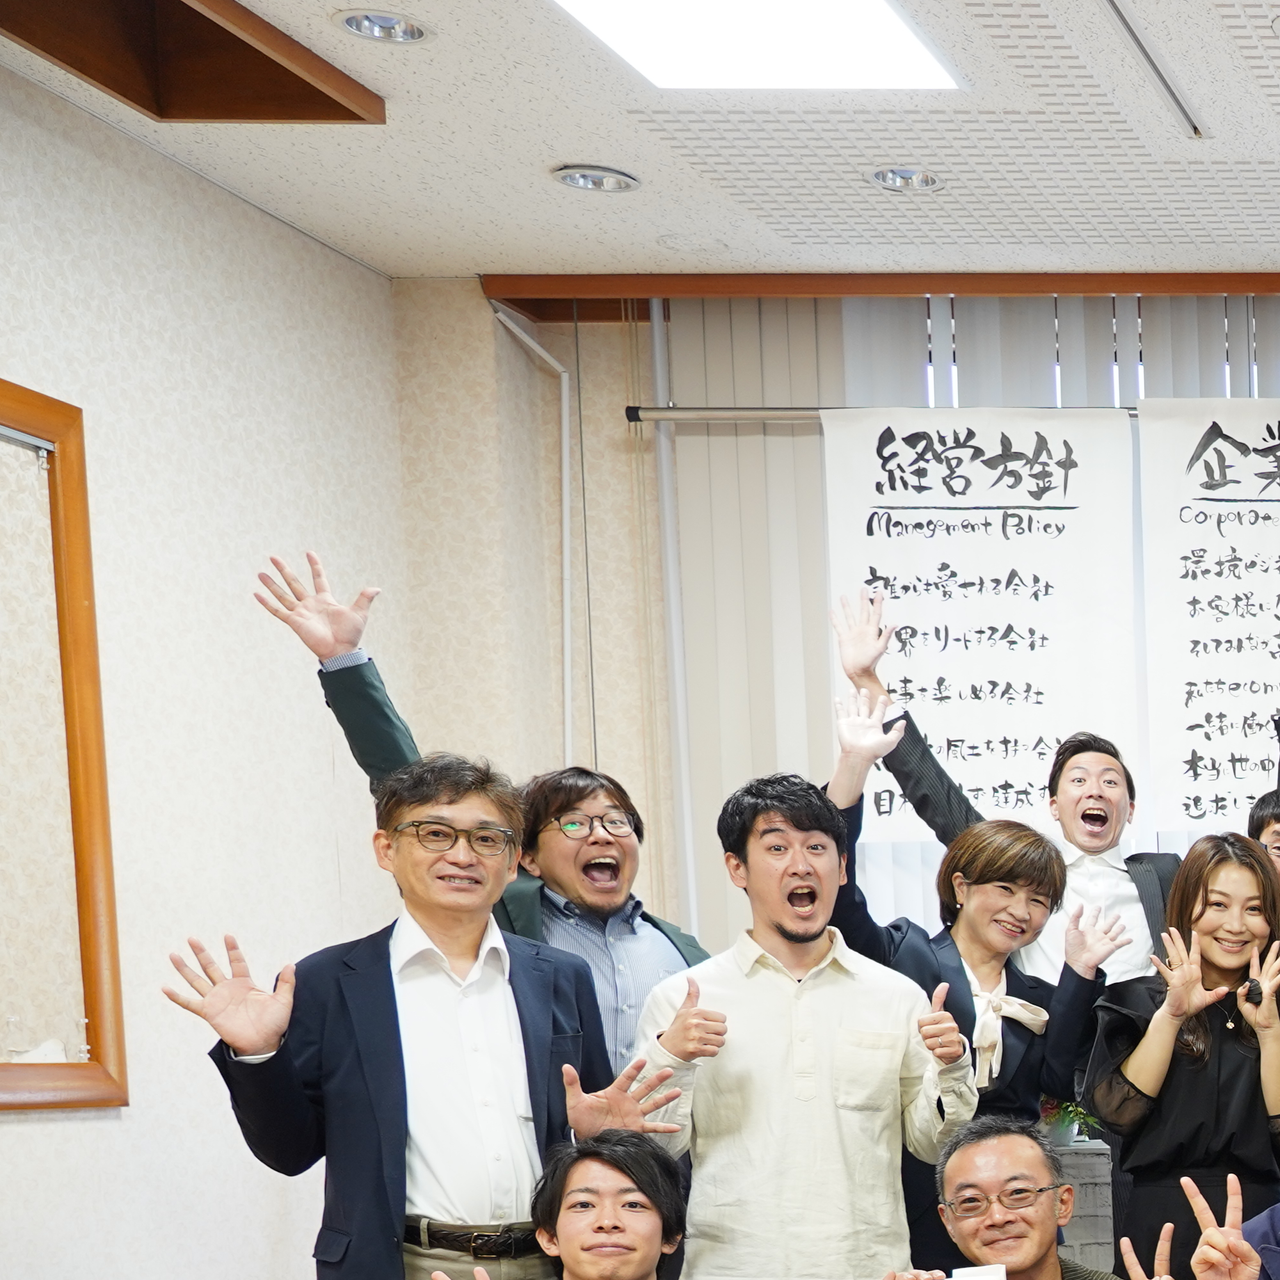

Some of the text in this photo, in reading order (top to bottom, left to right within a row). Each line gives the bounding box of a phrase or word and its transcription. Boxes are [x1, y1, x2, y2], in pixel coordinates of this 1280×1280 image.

[875, 426, 1078, 500] 経営方針
[1002, 510, 1066, 540] Policy
[1179, 506, 1280, 538] Corporate
[864, 562, 1055, 606] 誰からも愛される会社
[877, 623, 1049, 659] 界をリードする会社
